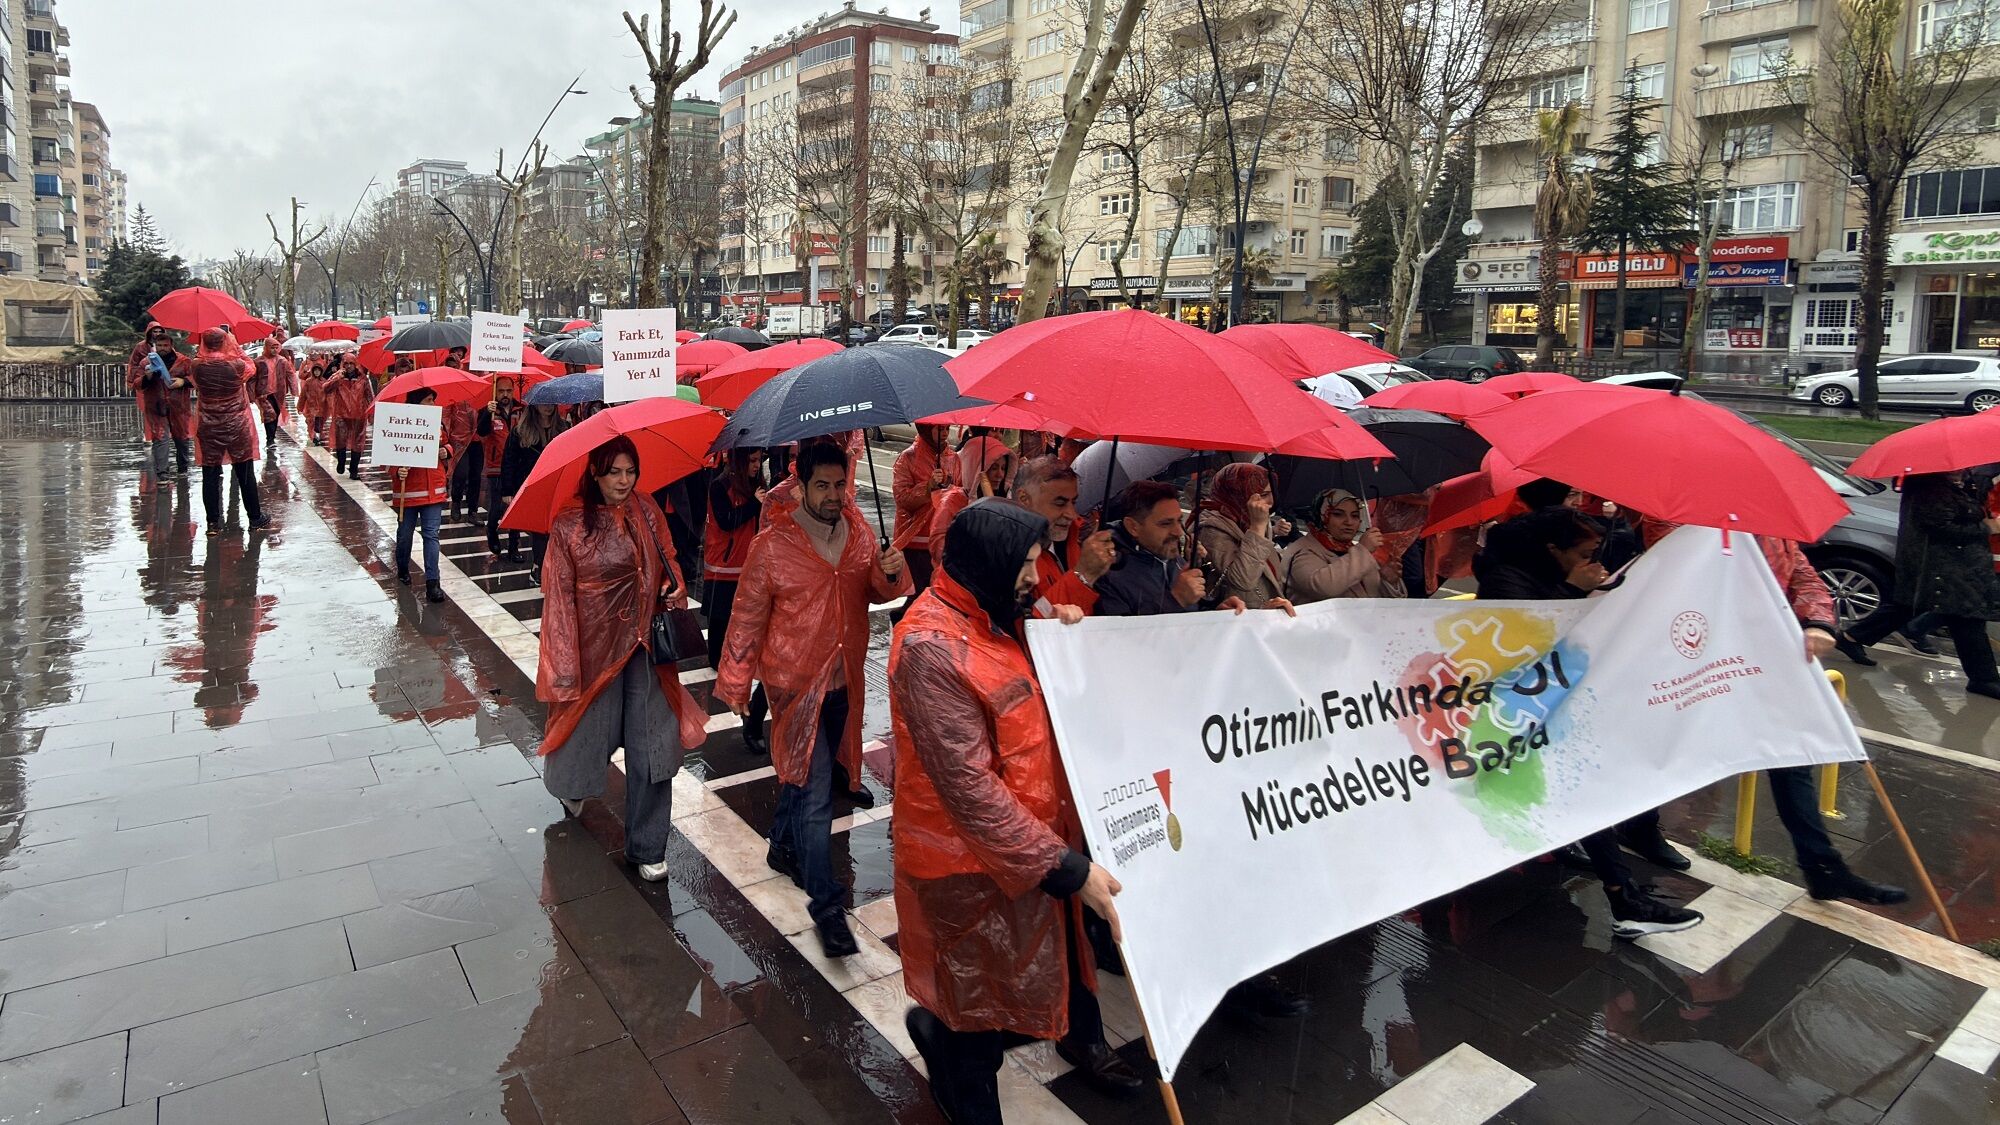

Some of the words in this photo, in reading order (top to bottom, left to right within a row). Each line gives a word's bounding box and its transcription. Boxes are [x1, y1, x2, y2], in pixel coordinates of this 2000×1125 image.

[1924, 231, 2000, 250] Kent
[1712, 245, 1774, 256] vodafone
[1585, 256, 1666, 273] DOBĞLU
[1742, 267, 1776, 275] Vizyon
[619, 329, 646, 341] Fark
[648, 328, 664, 341] Et,
[478, 355, 518, 363] Değiştirebilir
[612, 347, 671, 361] Yanımızda
[627, 369, 646, 380] Yer
[649, 367, 661, 379] Al
[800, 401, 873, 422] INESIS
[389, 416, 412, 425] Fark
[415, 418, 430, 428] Et,
[382, 429, 435, 441] Yanımızda
[394, 443, 411, 453] Yer
[412, 445, 424, 454] Al
[1703, 665, 1763, 687] HİZMETLER
[1652, 681, 1671, 692] T.C.
[1201, 697, 1322, 764] Otizmin
[1321, 676, 1495, 735] Farkında
[1241, 753, 1431, 841] Mücadeleye
